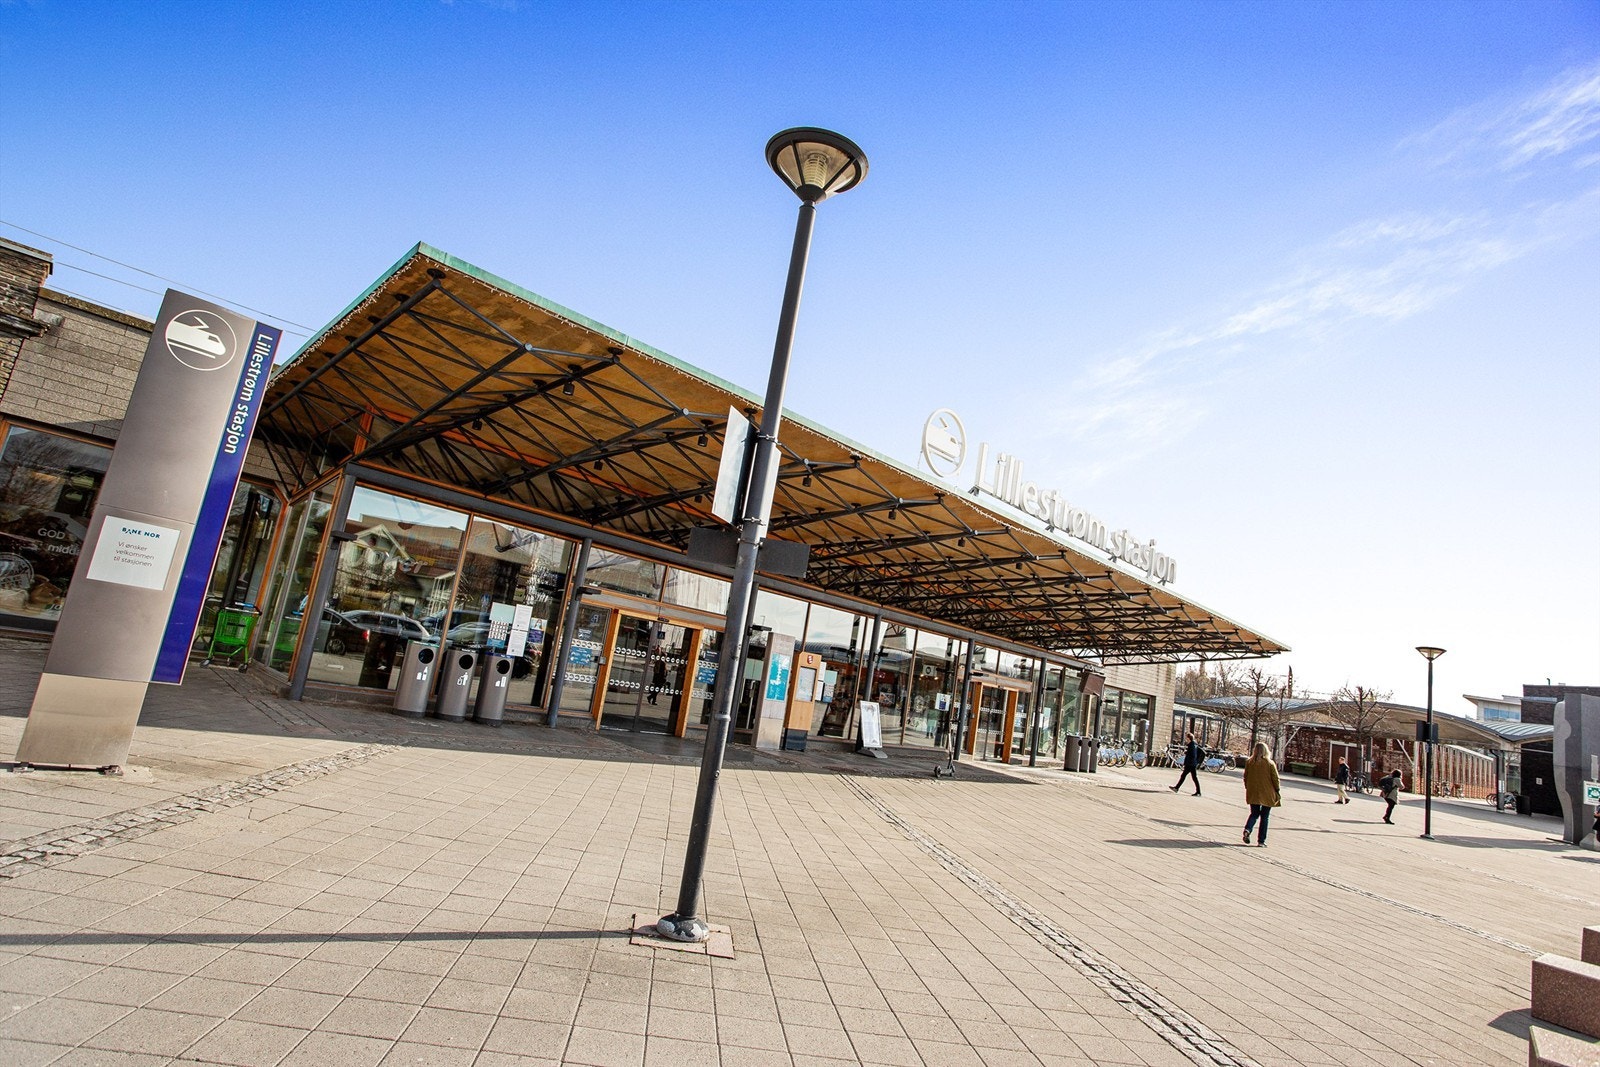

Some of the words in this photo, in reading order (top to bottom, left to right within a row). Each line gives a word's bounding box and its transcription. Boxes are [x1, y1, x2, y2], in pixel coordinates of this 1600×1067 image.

[240, 333, 274, 402] Lillestrøm
[224, 403, 250, 455] stasjon
[975, 442, 1110, 549] Lillestrøm
[1110, 529, 1178, 584] stasjon
[37, 527, 66, 540] GOD
[121, 527, 142, 535] BANE
[143, 531, 161, 539] NOR
[125, 543, 148, 552] ønsker
[115, 549, 155, 560] velkommen
[121, 556, 153, 568] stasjonen
